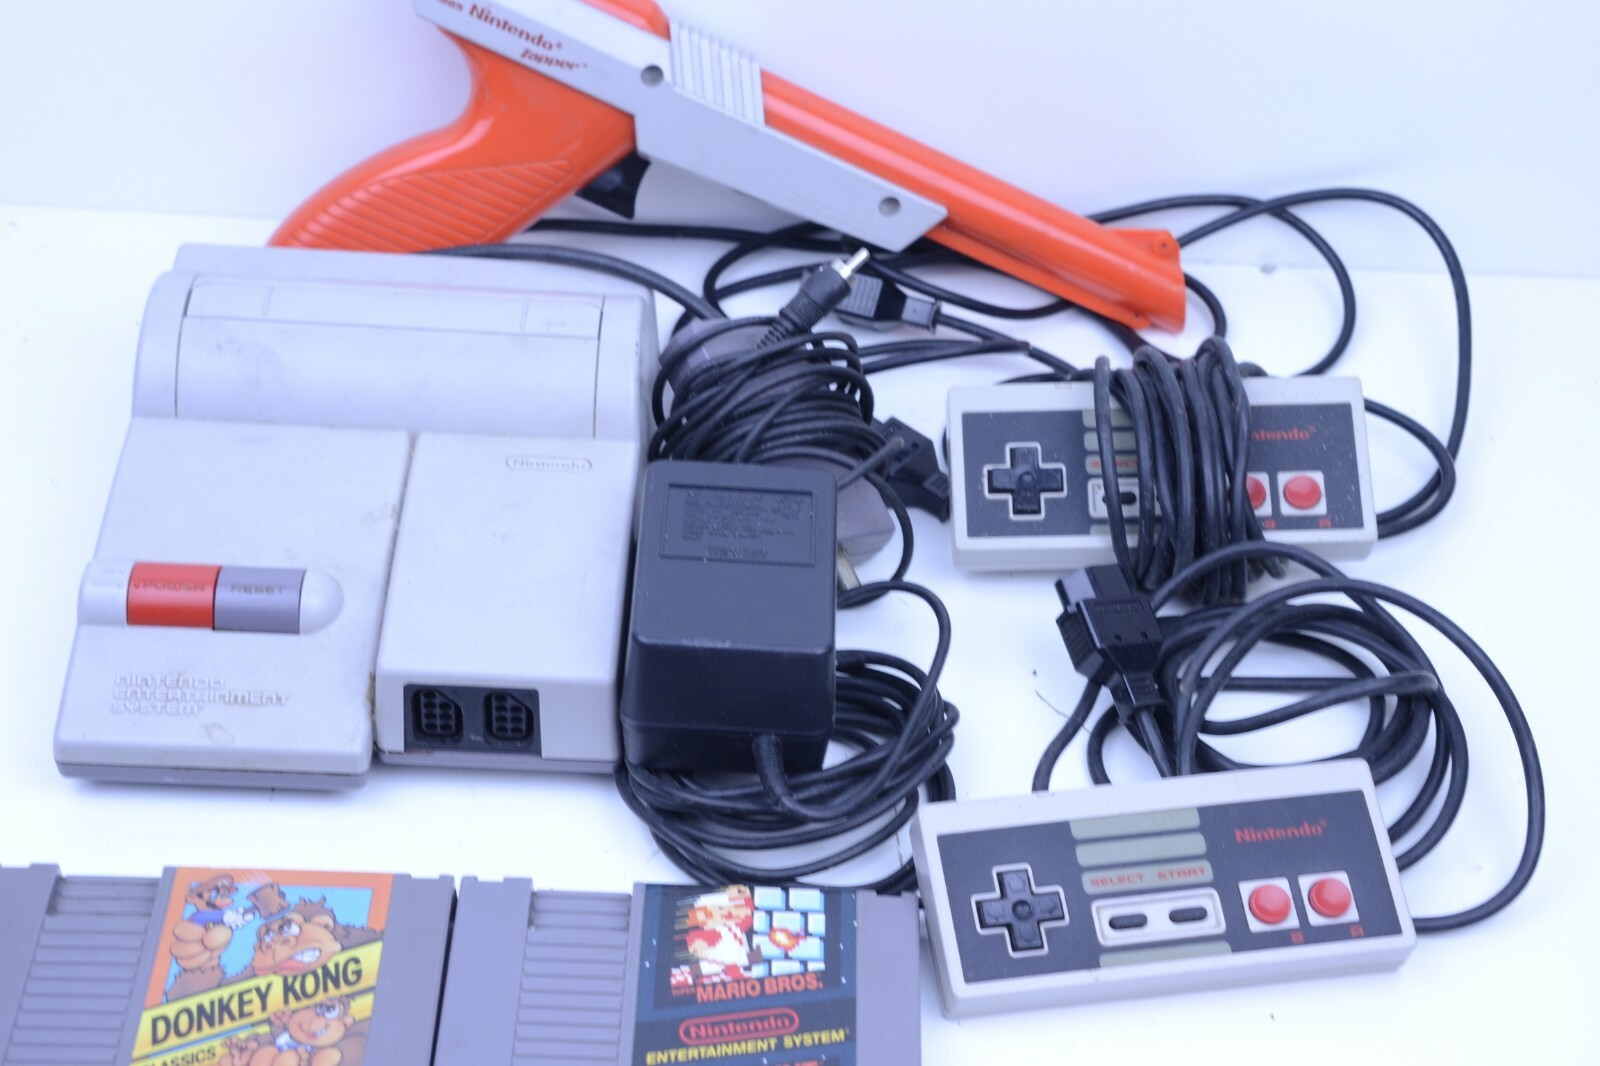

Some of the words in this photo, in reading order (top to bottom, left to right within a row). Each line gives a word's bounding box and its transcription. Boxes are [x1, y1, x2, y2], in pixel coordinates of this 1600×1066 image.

[468, 3, 554, 51] Nintendo
[1252, 427, 1310, 441] ntendo
[230, 583, 287, 595] RESET
[114, 672, 224, 690] NINTENDO
[112, 686, 289, 706] ENTERTAINMENT
[110, 701, 200, 716] SYSTEM
[1235, 820, 1320, 843] Nintendo
[1090, 872, 1145, 888] SELECT
[1157, 866, 1207, 881] START
[696, 978, 762, 1004] MARIO
[764, 972, 824, 995] BROS.
[151, 983, 273, 1046] DONKEY
[283, 956, 362, 1006] KONG
[688, 1015, 791, 1039] Nintendo
[646, 1037, 777, 1066] ENTERTAINMENT
[783, 1028, 846, 1049] SYSTEM
